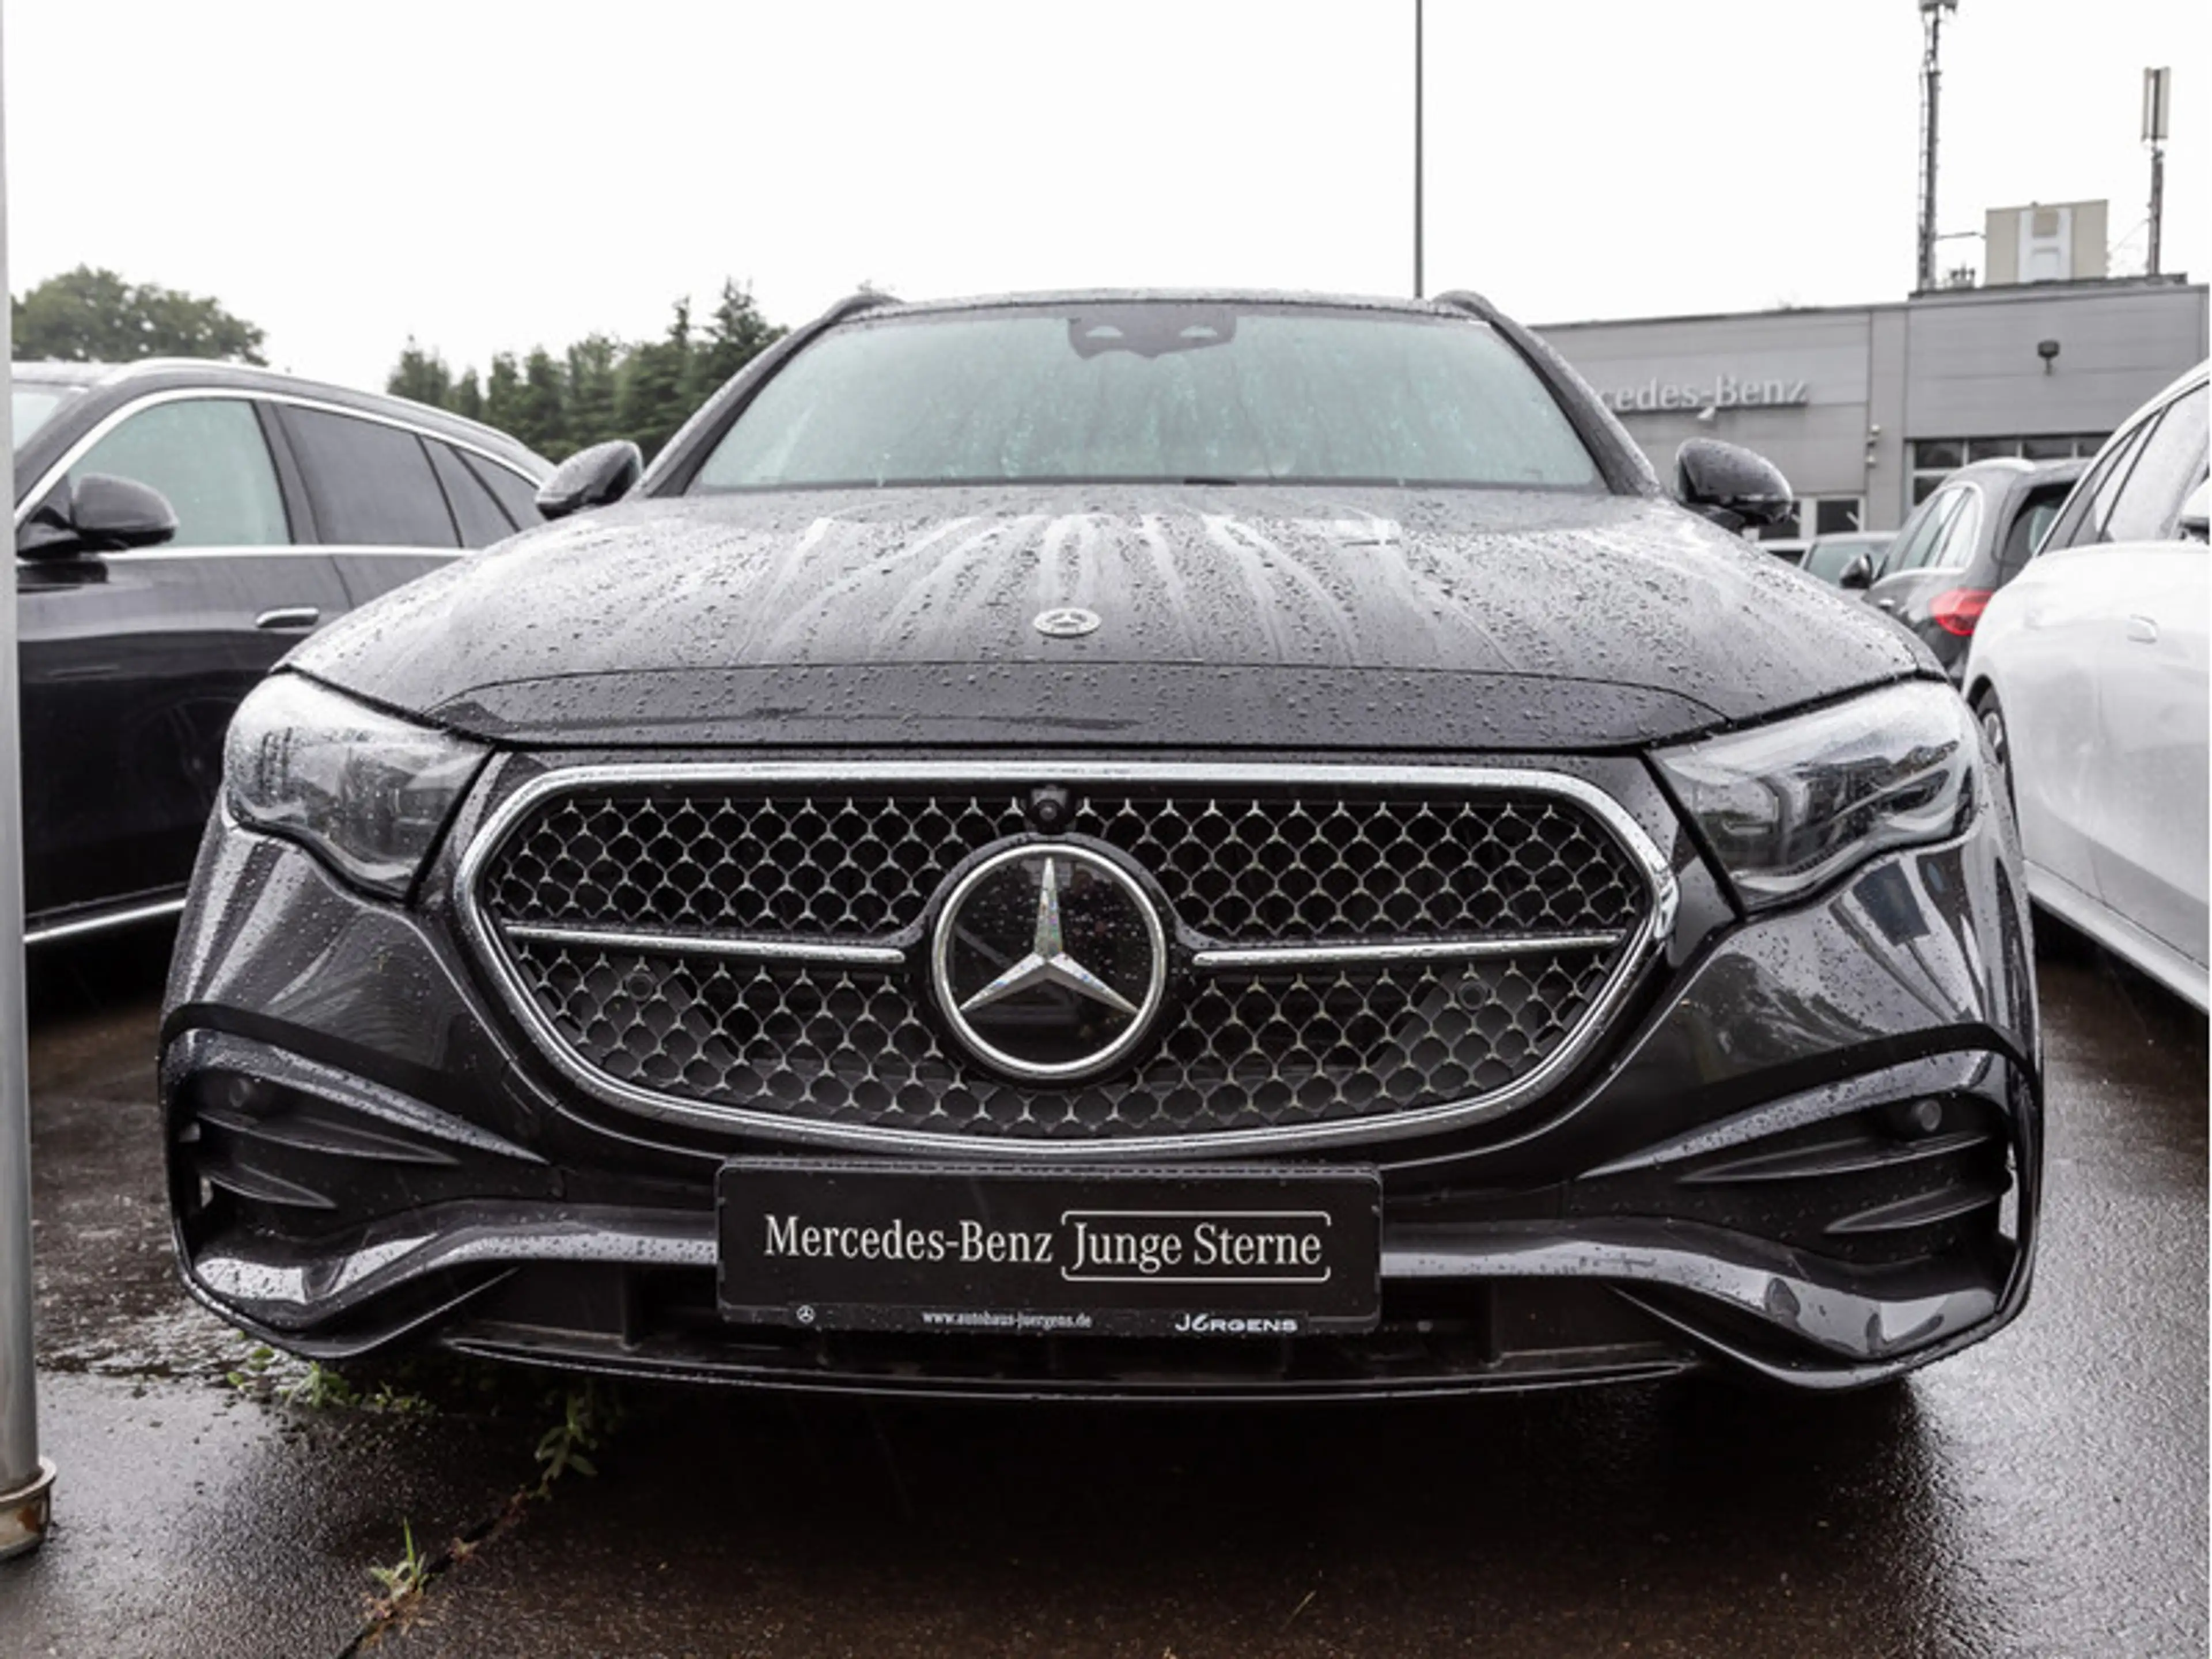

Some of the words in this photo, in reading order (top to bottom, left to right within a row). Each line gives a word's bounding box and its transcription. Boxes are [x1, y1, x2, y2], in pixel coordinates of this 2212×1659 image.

[763, 1214, 1054, 1263] Mercedes-Benz
[1071, 1222, 1182, 1274] Junge
[1194, 1222, 1323, 1266] Sterne
